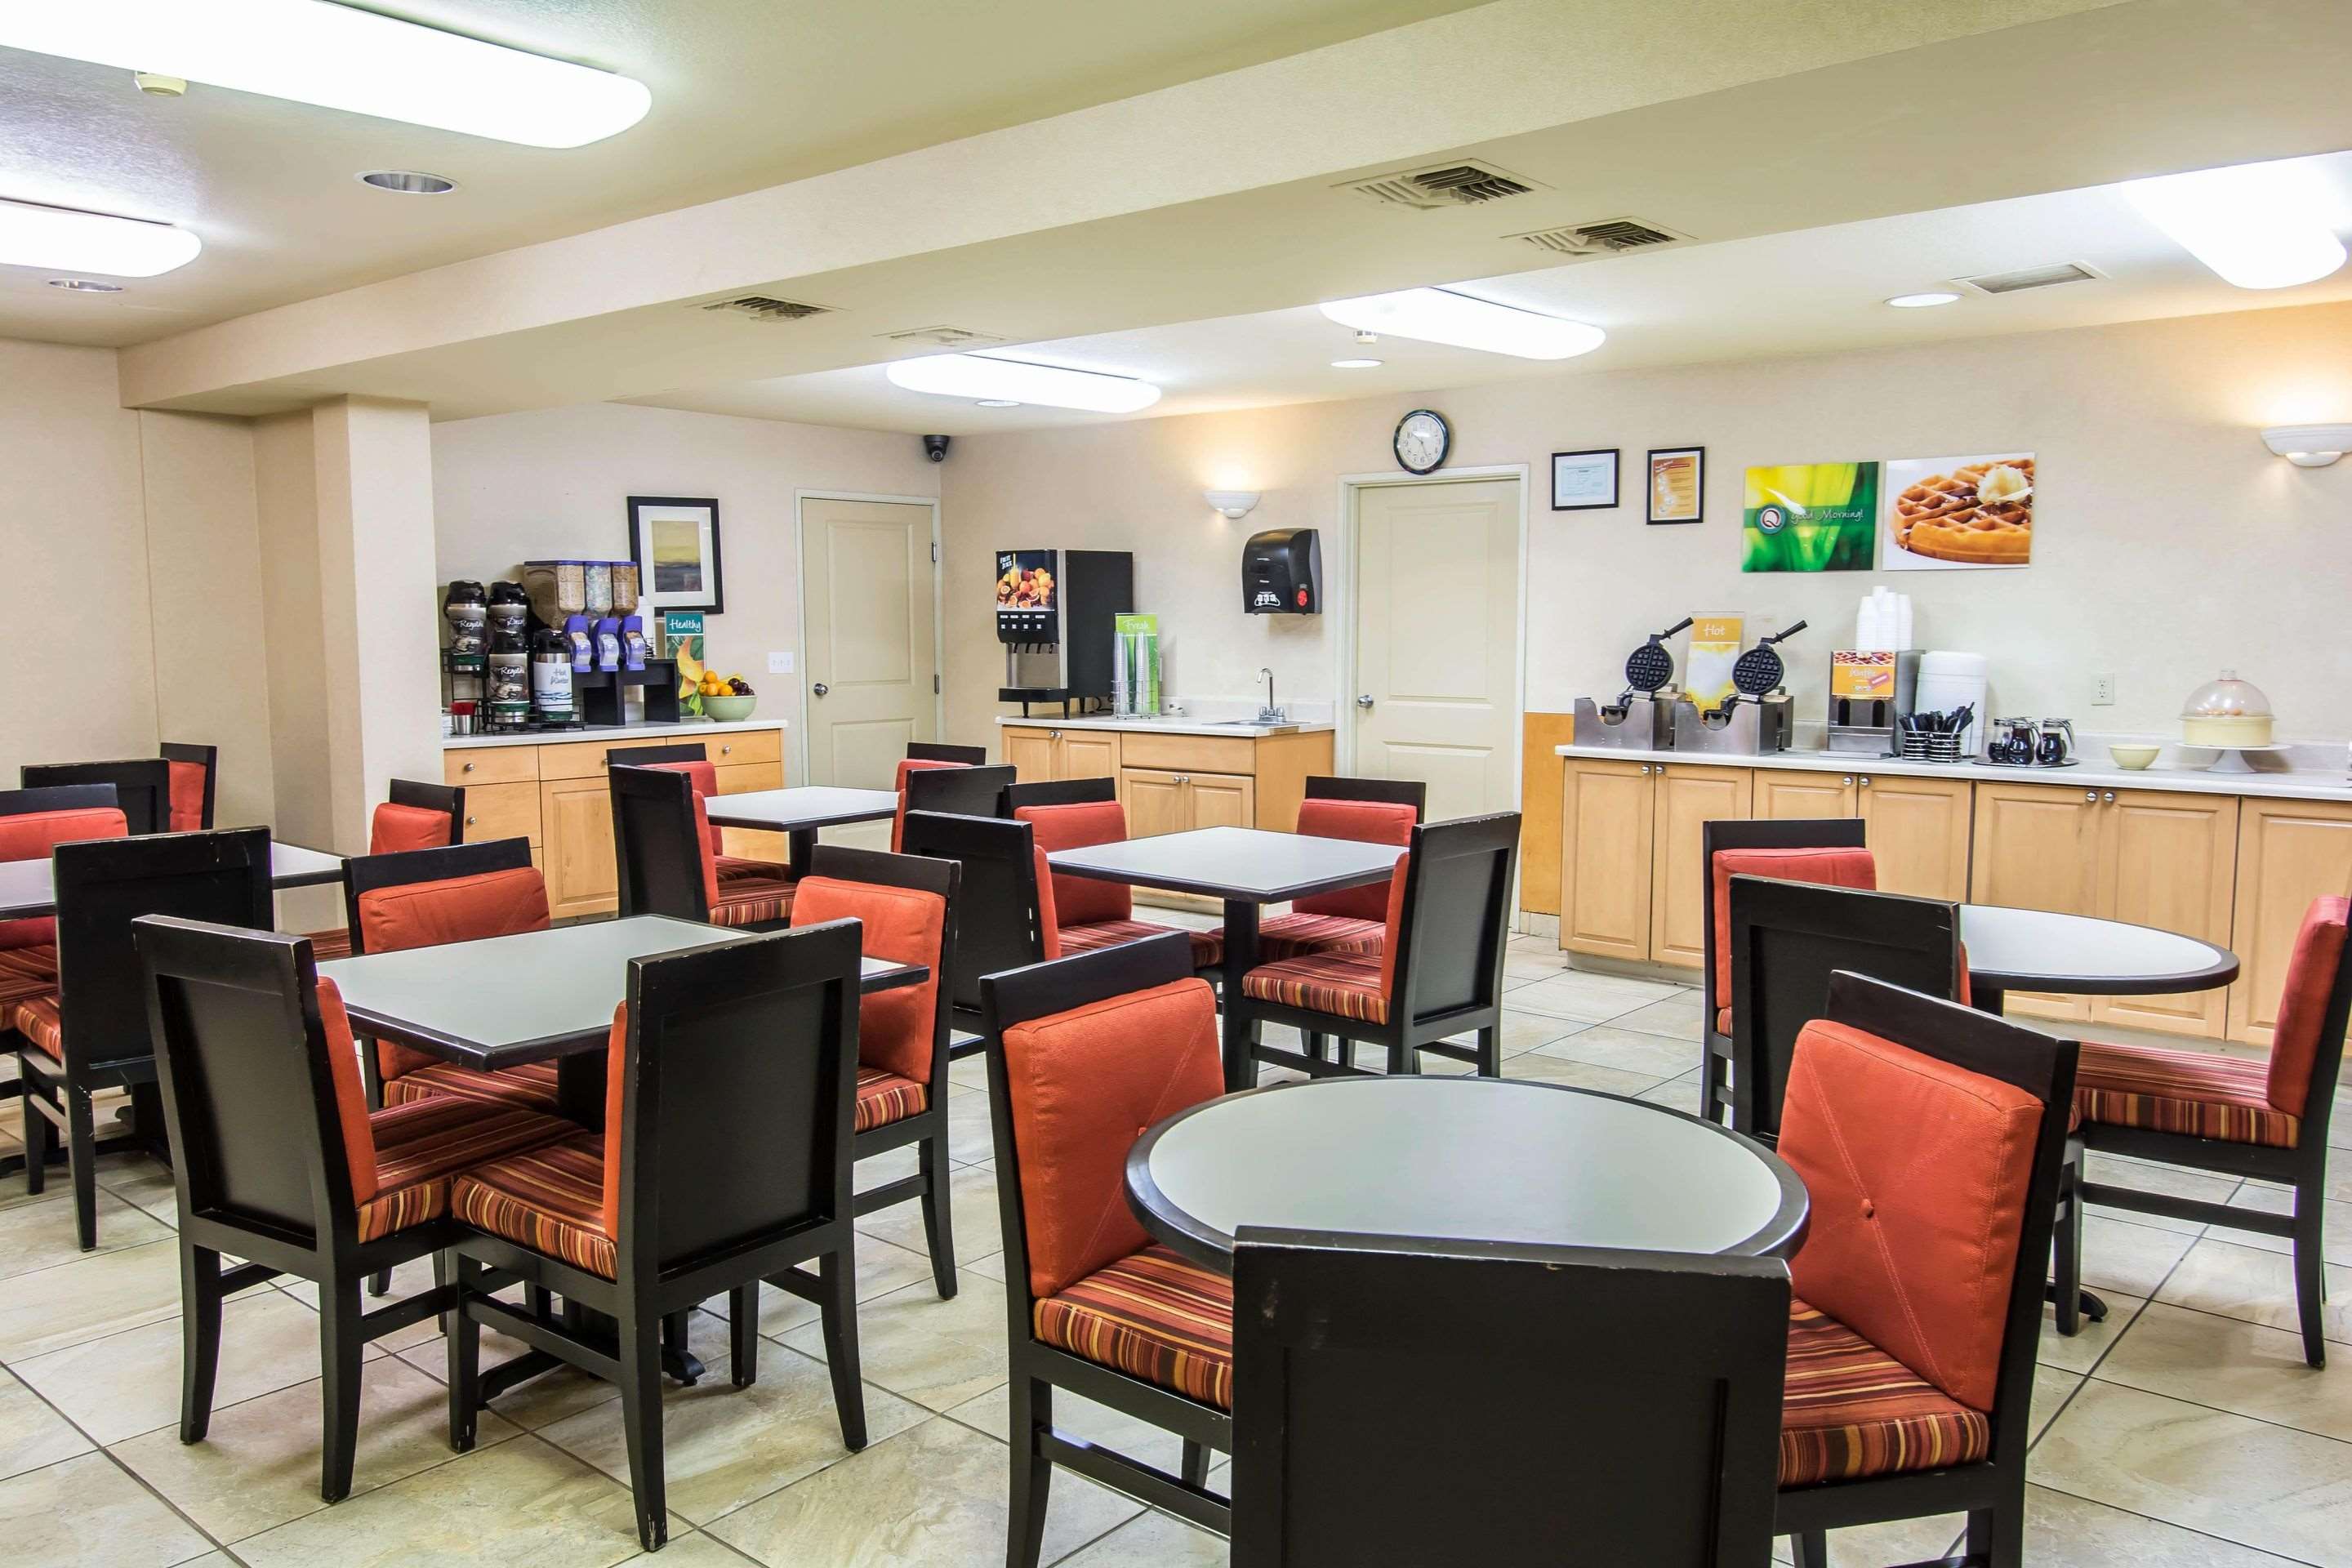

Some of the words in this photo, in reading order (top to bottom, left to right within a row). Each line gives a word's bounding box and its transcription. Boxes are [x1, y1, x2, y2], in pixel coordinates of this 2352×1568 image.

[1816, 509, 1864, 522] Morning!
[669, 618, 702, 633] Healthy
[1123, 619, 1149, 630] Fresh
[1704, 624, 1725, 637] Hot
